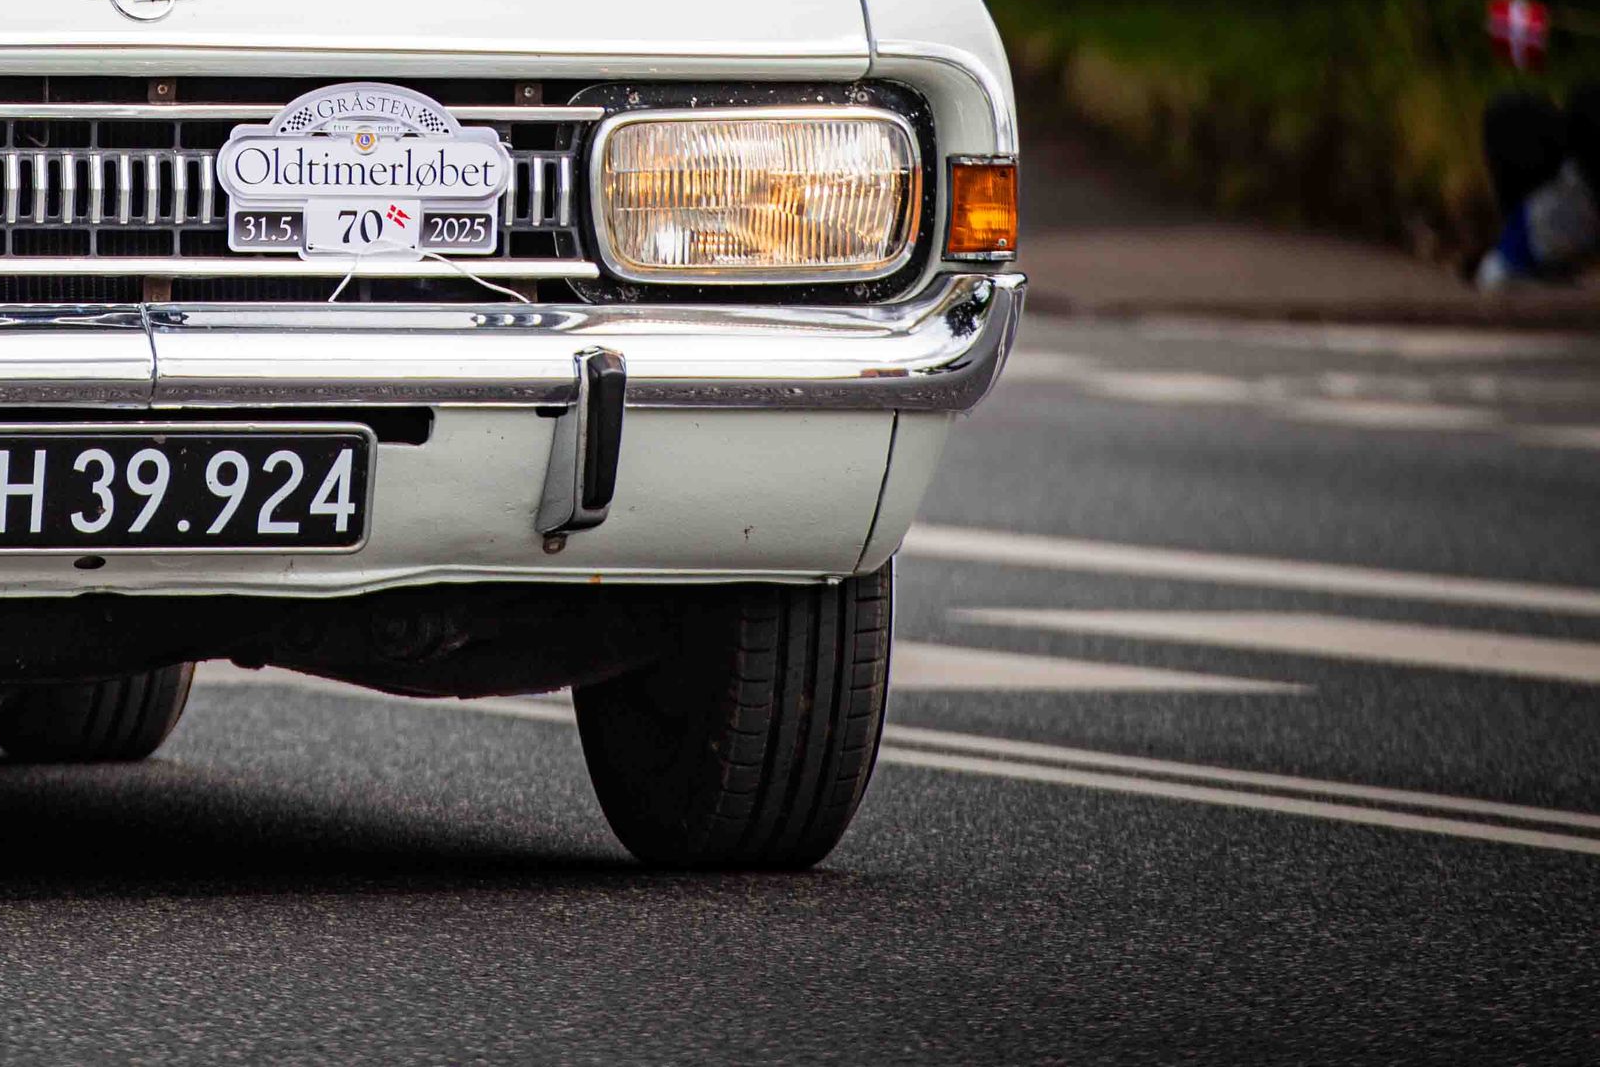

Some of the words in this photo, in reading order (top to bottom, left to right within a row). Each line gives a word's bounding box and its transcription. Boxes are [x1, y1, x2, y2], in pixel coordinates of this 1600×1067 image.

[317, 90, 416, 119] GRÅSTEN
[235, 146, 496, 192] Oldtimerløbet
[240, 216, 299, 241] 31.5.
[337, 209, 384, 244] 70
[429, 217, 486, 242] 2025
[70, 448, 356, 535] 39.924
